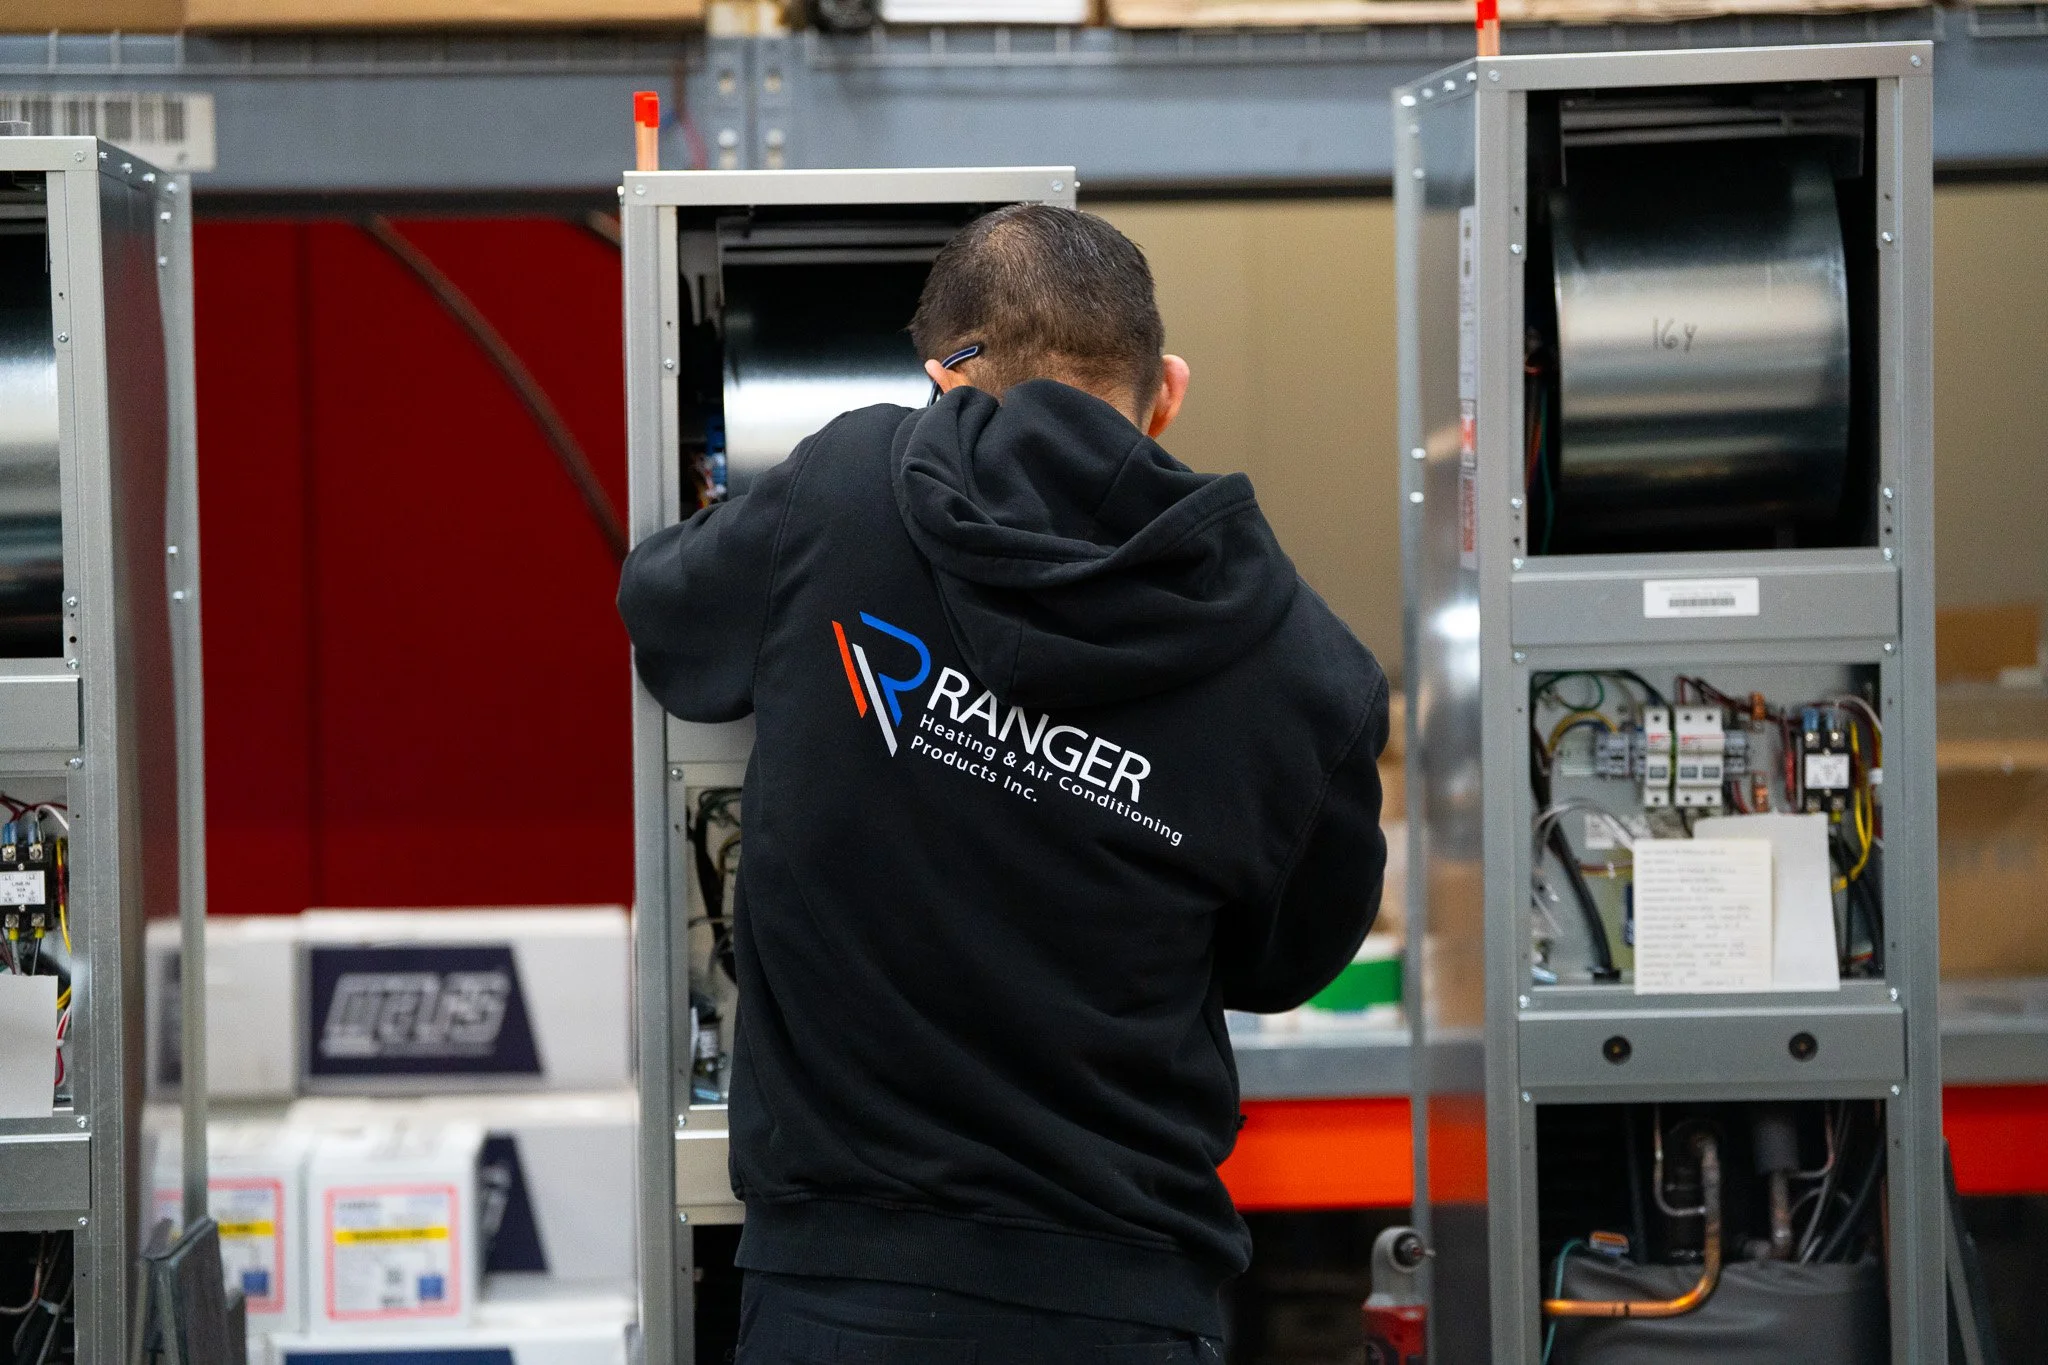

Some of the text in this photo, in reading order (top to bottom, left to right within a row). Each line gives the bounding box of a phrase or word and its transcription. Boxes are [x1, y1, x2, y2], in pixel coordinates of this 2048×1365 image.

[910, 734, 1038, 803] Products Inc.
[919, 713, 1183, 847] Heating & Air Conditioning
[927, 667, 1152, 803] RANGER
